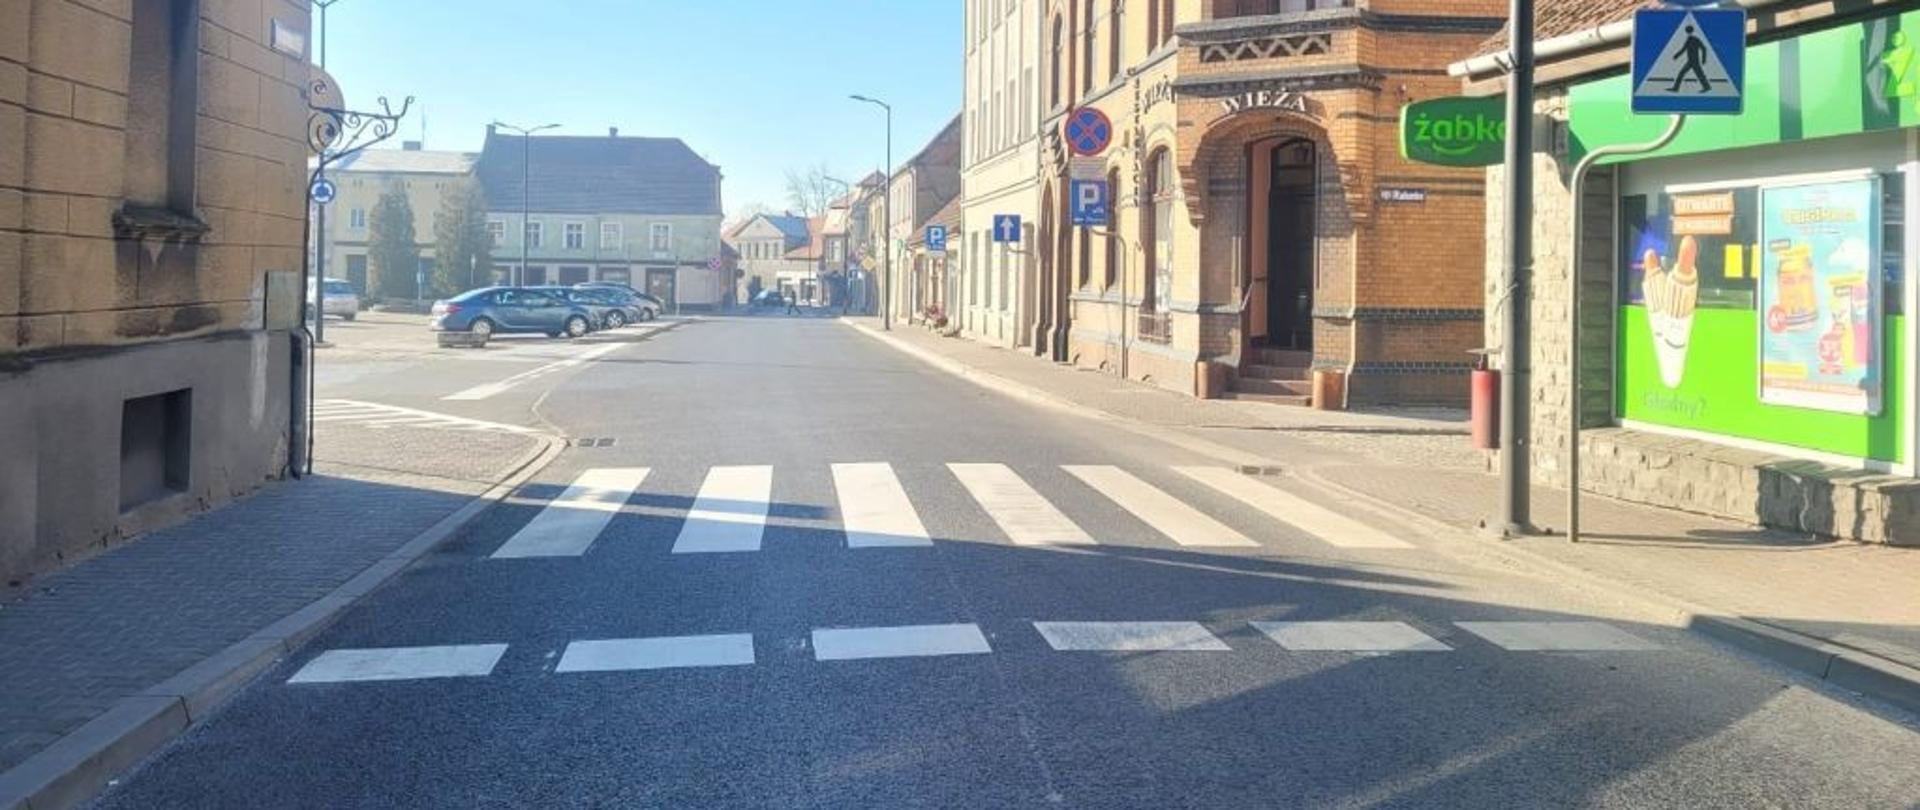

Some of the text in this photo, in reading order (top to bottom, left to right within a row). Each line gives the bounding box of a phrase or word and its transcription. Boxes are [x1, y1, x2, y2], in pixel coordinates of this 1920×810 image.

[1221, 86, 1306, 114] WIEŻA
[1079, 184, 1100, 212] P
[930, 228, 943, 244] P
